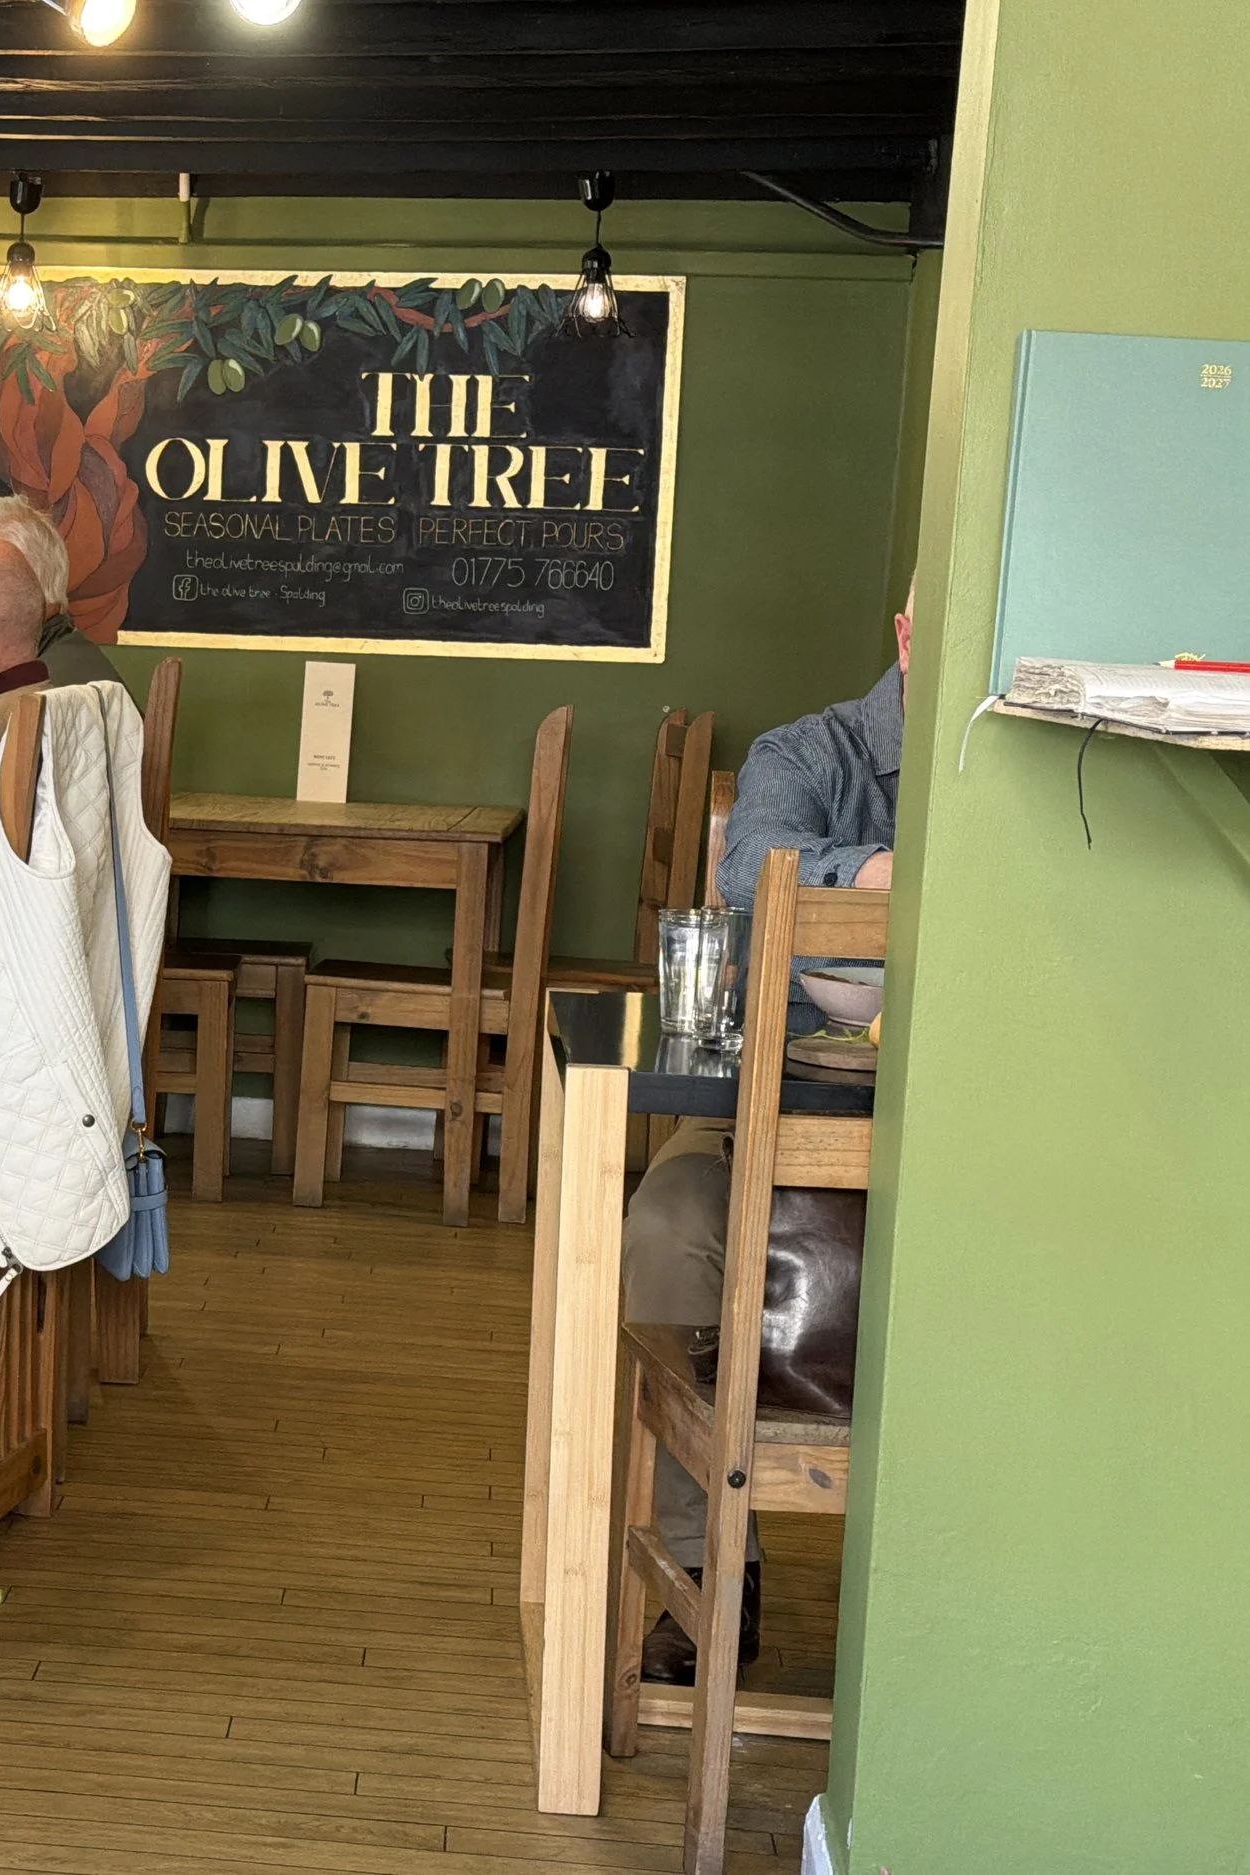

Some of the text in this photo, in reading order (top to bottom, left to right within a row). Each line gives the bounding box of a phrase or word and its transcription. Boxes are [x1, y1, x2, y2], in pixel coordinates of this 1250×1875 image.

[1200, 377, 1231, 389] 2027
[1201, 363, 1232, 375] 2026
[361, 371, 531, 440] THE
[145, 436, 646, 514] OLIVE TREE
[163, 510, 626, 551] SEASONAL PLATES PERFECT POURS
[451, 556, 616, 591] 01775 766640
[200, 583, 220, 597] the
[221, 583, 246, 598] olive
[249, 584, 271, 598] tree
[280, 585, 327, 608] Spalding
